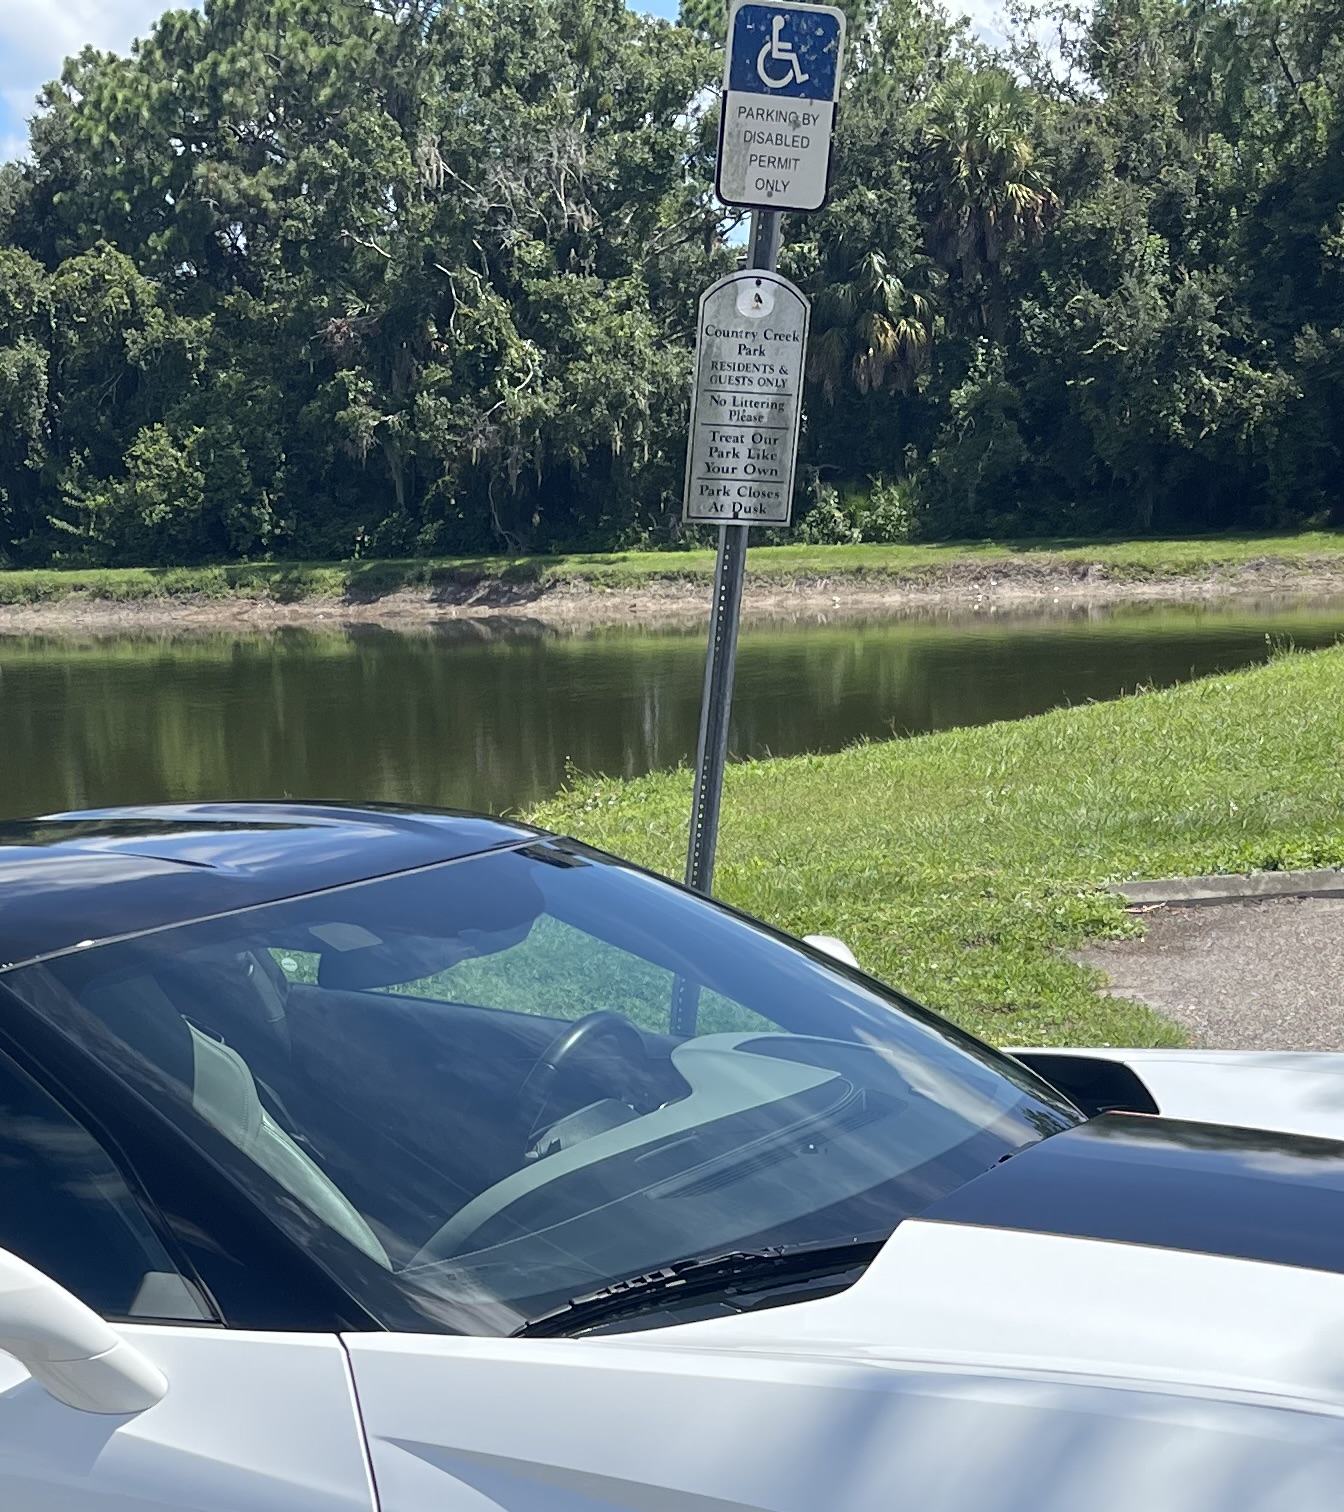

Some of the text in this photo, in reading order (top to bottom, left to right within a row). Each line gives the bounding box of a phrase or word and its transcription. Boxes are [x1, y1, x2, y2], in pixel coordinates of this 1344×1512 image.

[737, 105, 820, 127] PARKING BY
[743, 130, 810, 149] DISABLED
[748, 153, 800, 171] PERMIT
[754, 177, 790, 193] ONLY
[705, 324, 800, 342] Country Creek
[737, 343, 766, 357] Park
[710, 360, 789, 375] RESIDENTS &
[709, 374, 788, 389] GUESTS ONLY
[709, 395, 785, 412] No Littering
[728, 409, 764, 423] Please
[709, 430, 779, 446] Treat Our
[708, 446, 777, 461] Park Like
[704, 461, 778, 477] Your Own
[699, 484, 780, 499] Park Closes
[708, 501, 767, 515] At Dusk
